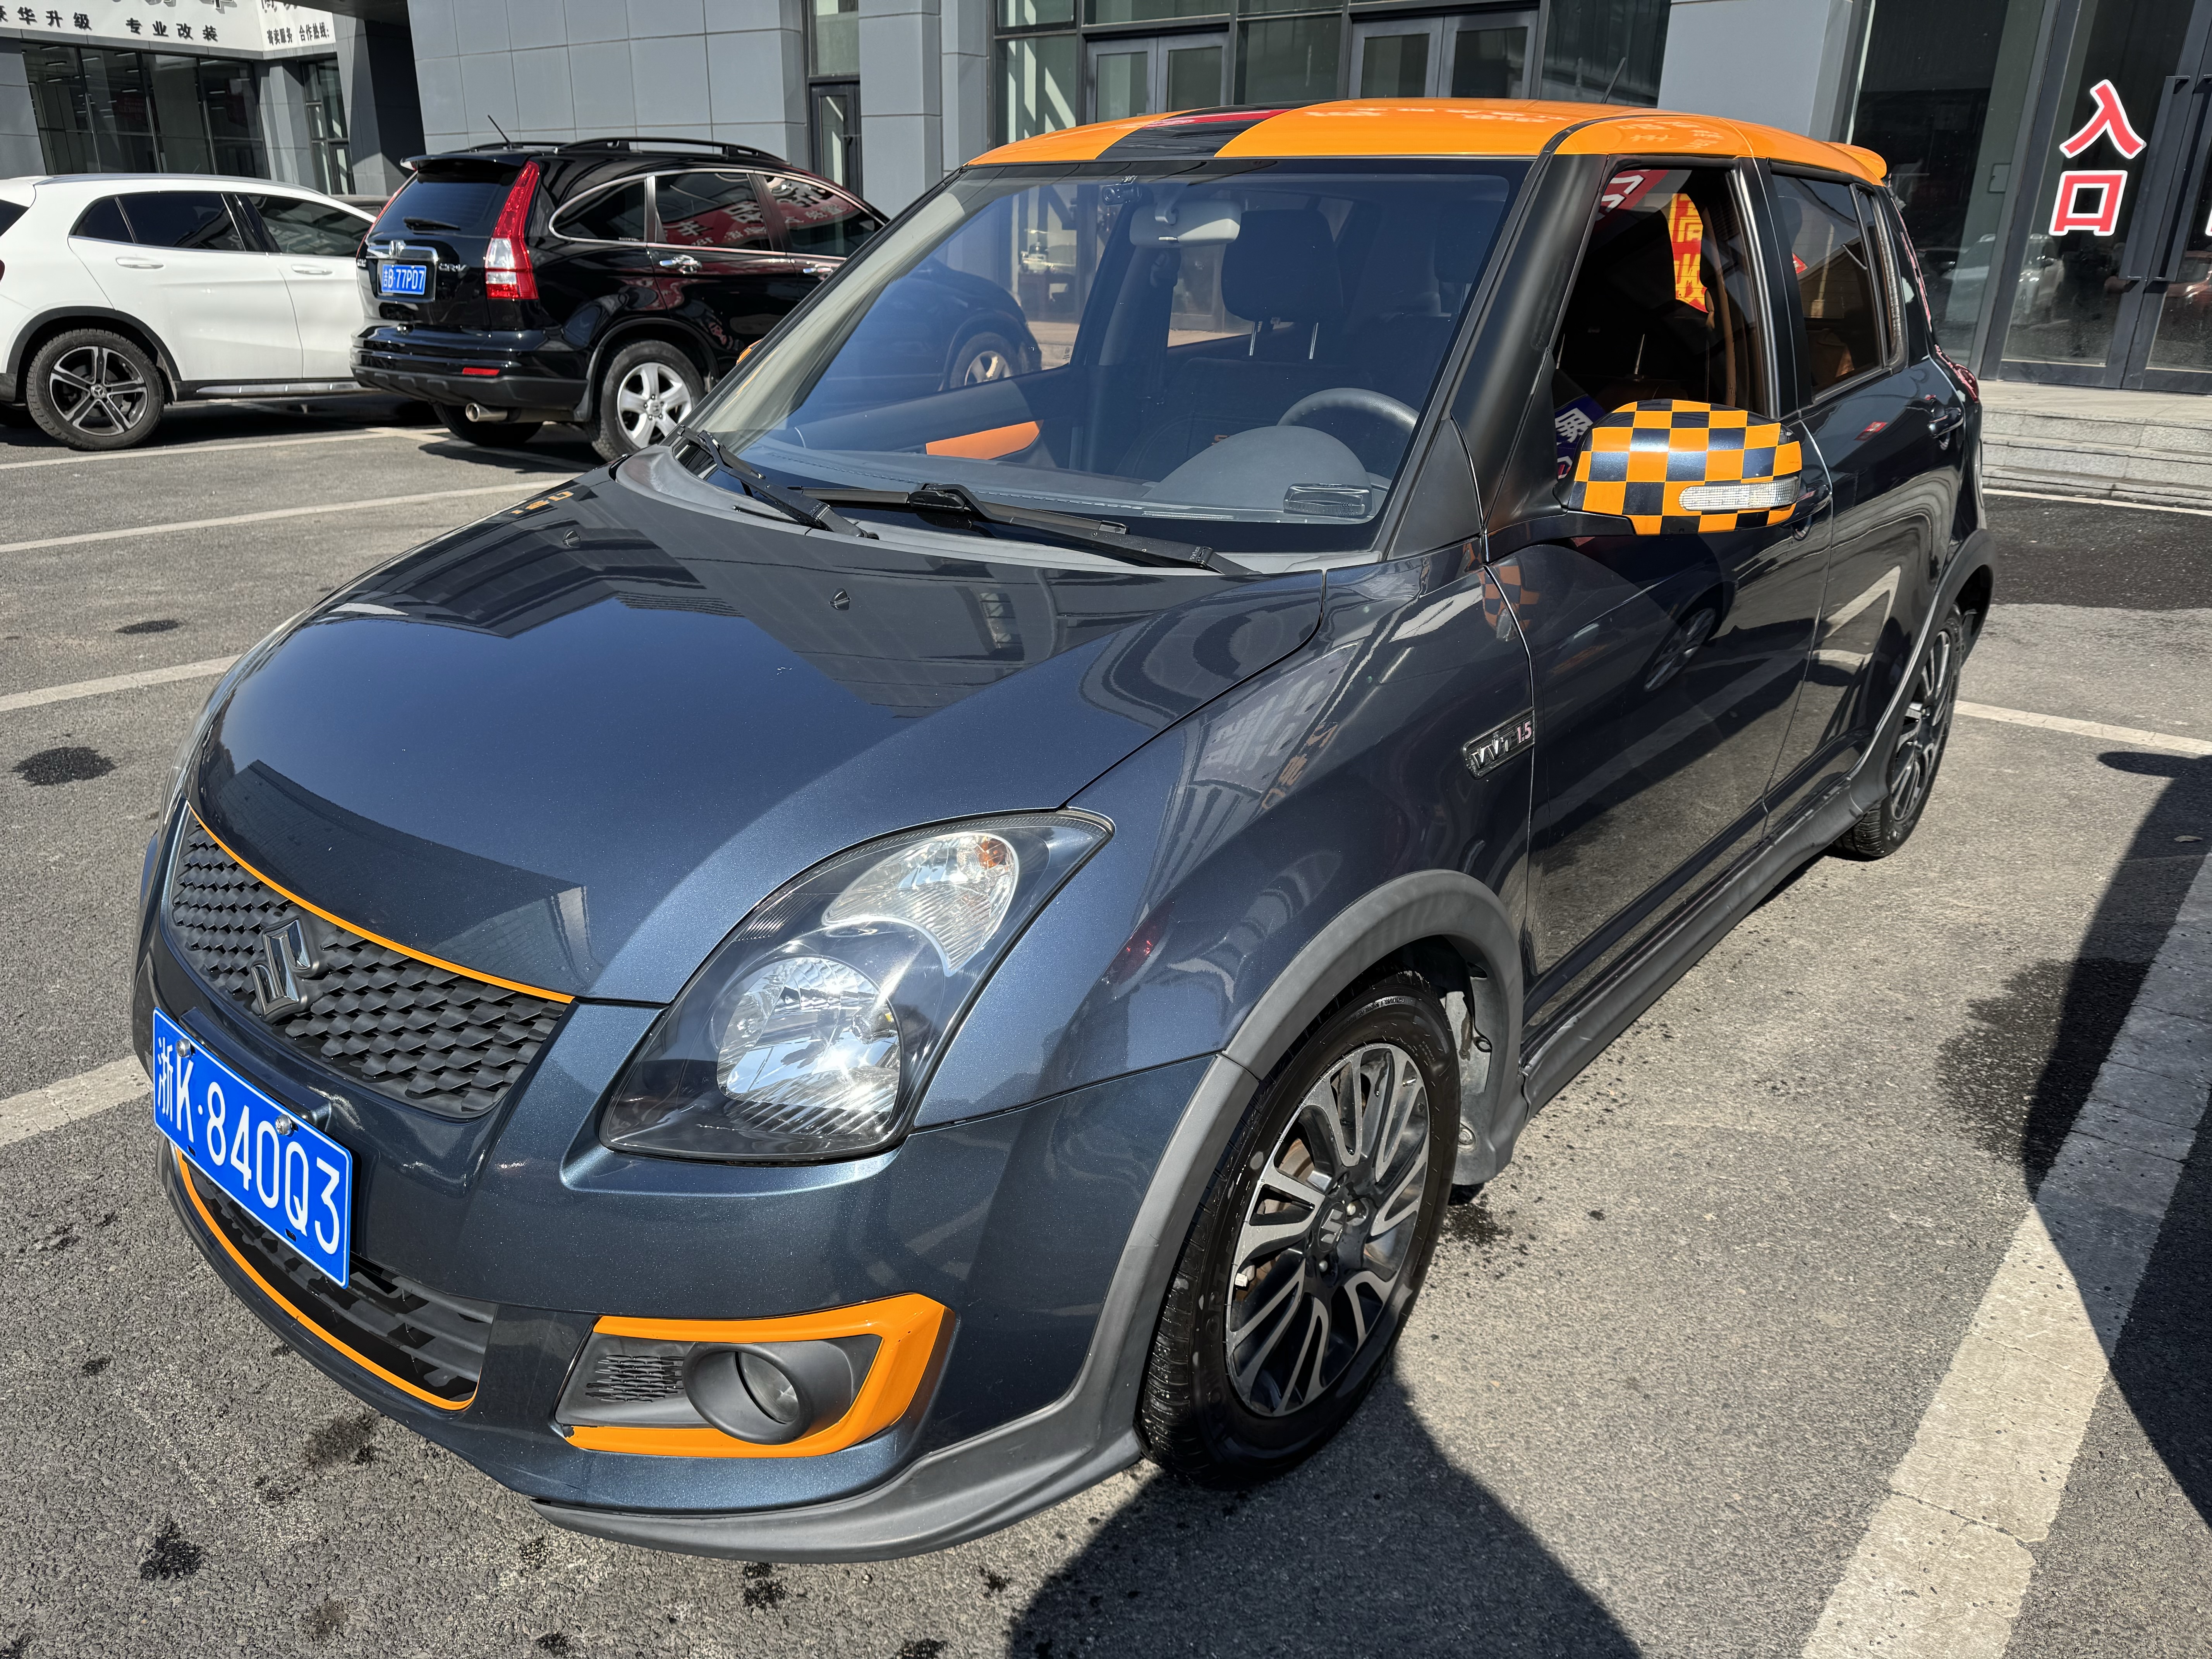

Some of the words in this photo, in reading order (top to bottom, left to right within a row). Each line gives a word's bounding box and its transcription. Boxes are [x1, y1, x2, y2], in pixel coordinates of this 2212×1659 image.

[125, 17, 218, 42] 专业改装
[2049, 79, 2147, 236] 入口
